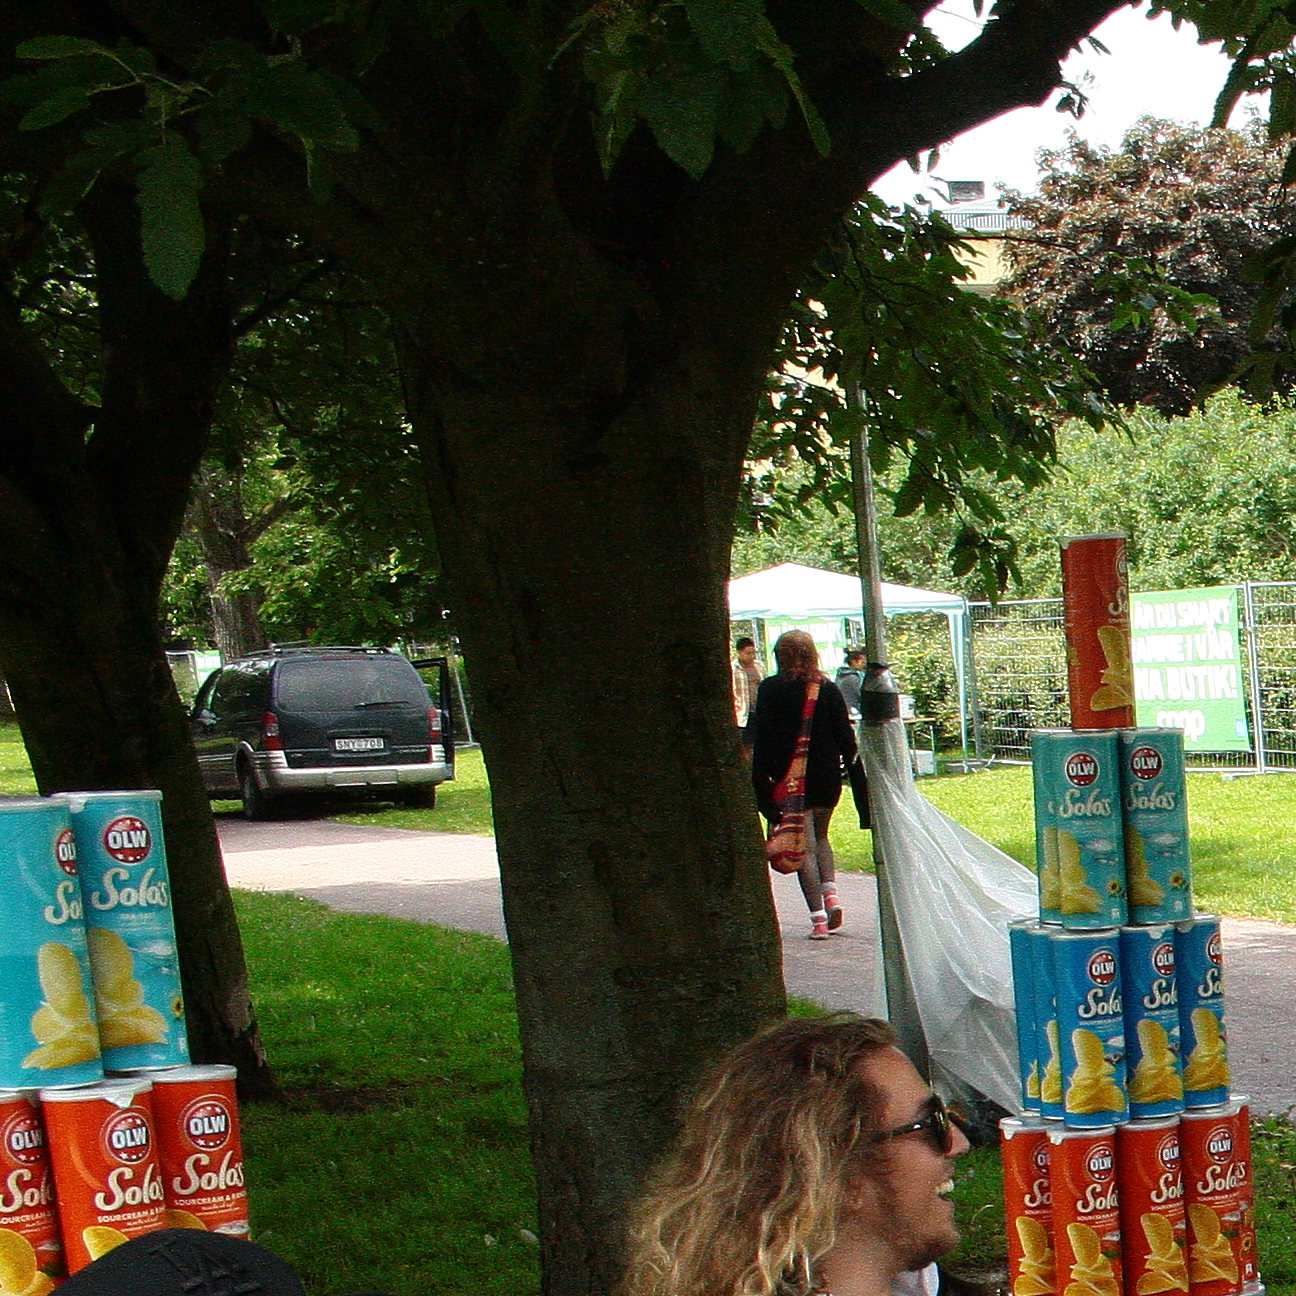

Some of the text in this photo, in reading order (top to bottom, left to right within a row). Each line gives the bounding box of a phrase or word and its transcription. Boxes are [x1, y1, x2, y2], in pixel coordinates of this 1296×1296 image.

[1194, 624, 1235, 661] VÅR
[1134, 664, 1238, 701] NA BUTIK!
[1068, 762, 1095, 777] OLW
[1133, 756, 1159, 770] OLW
[107, 829, 148, 849] OLW
[1091, 961, 1114, 976] OLW
[190, 1114, 226, 1137] OLW
[111, 1126, 147, 1150] OLW
[1209, 1138, 1232, 1154] OLW
[1090, 1156, 1112, 1173] OLW
